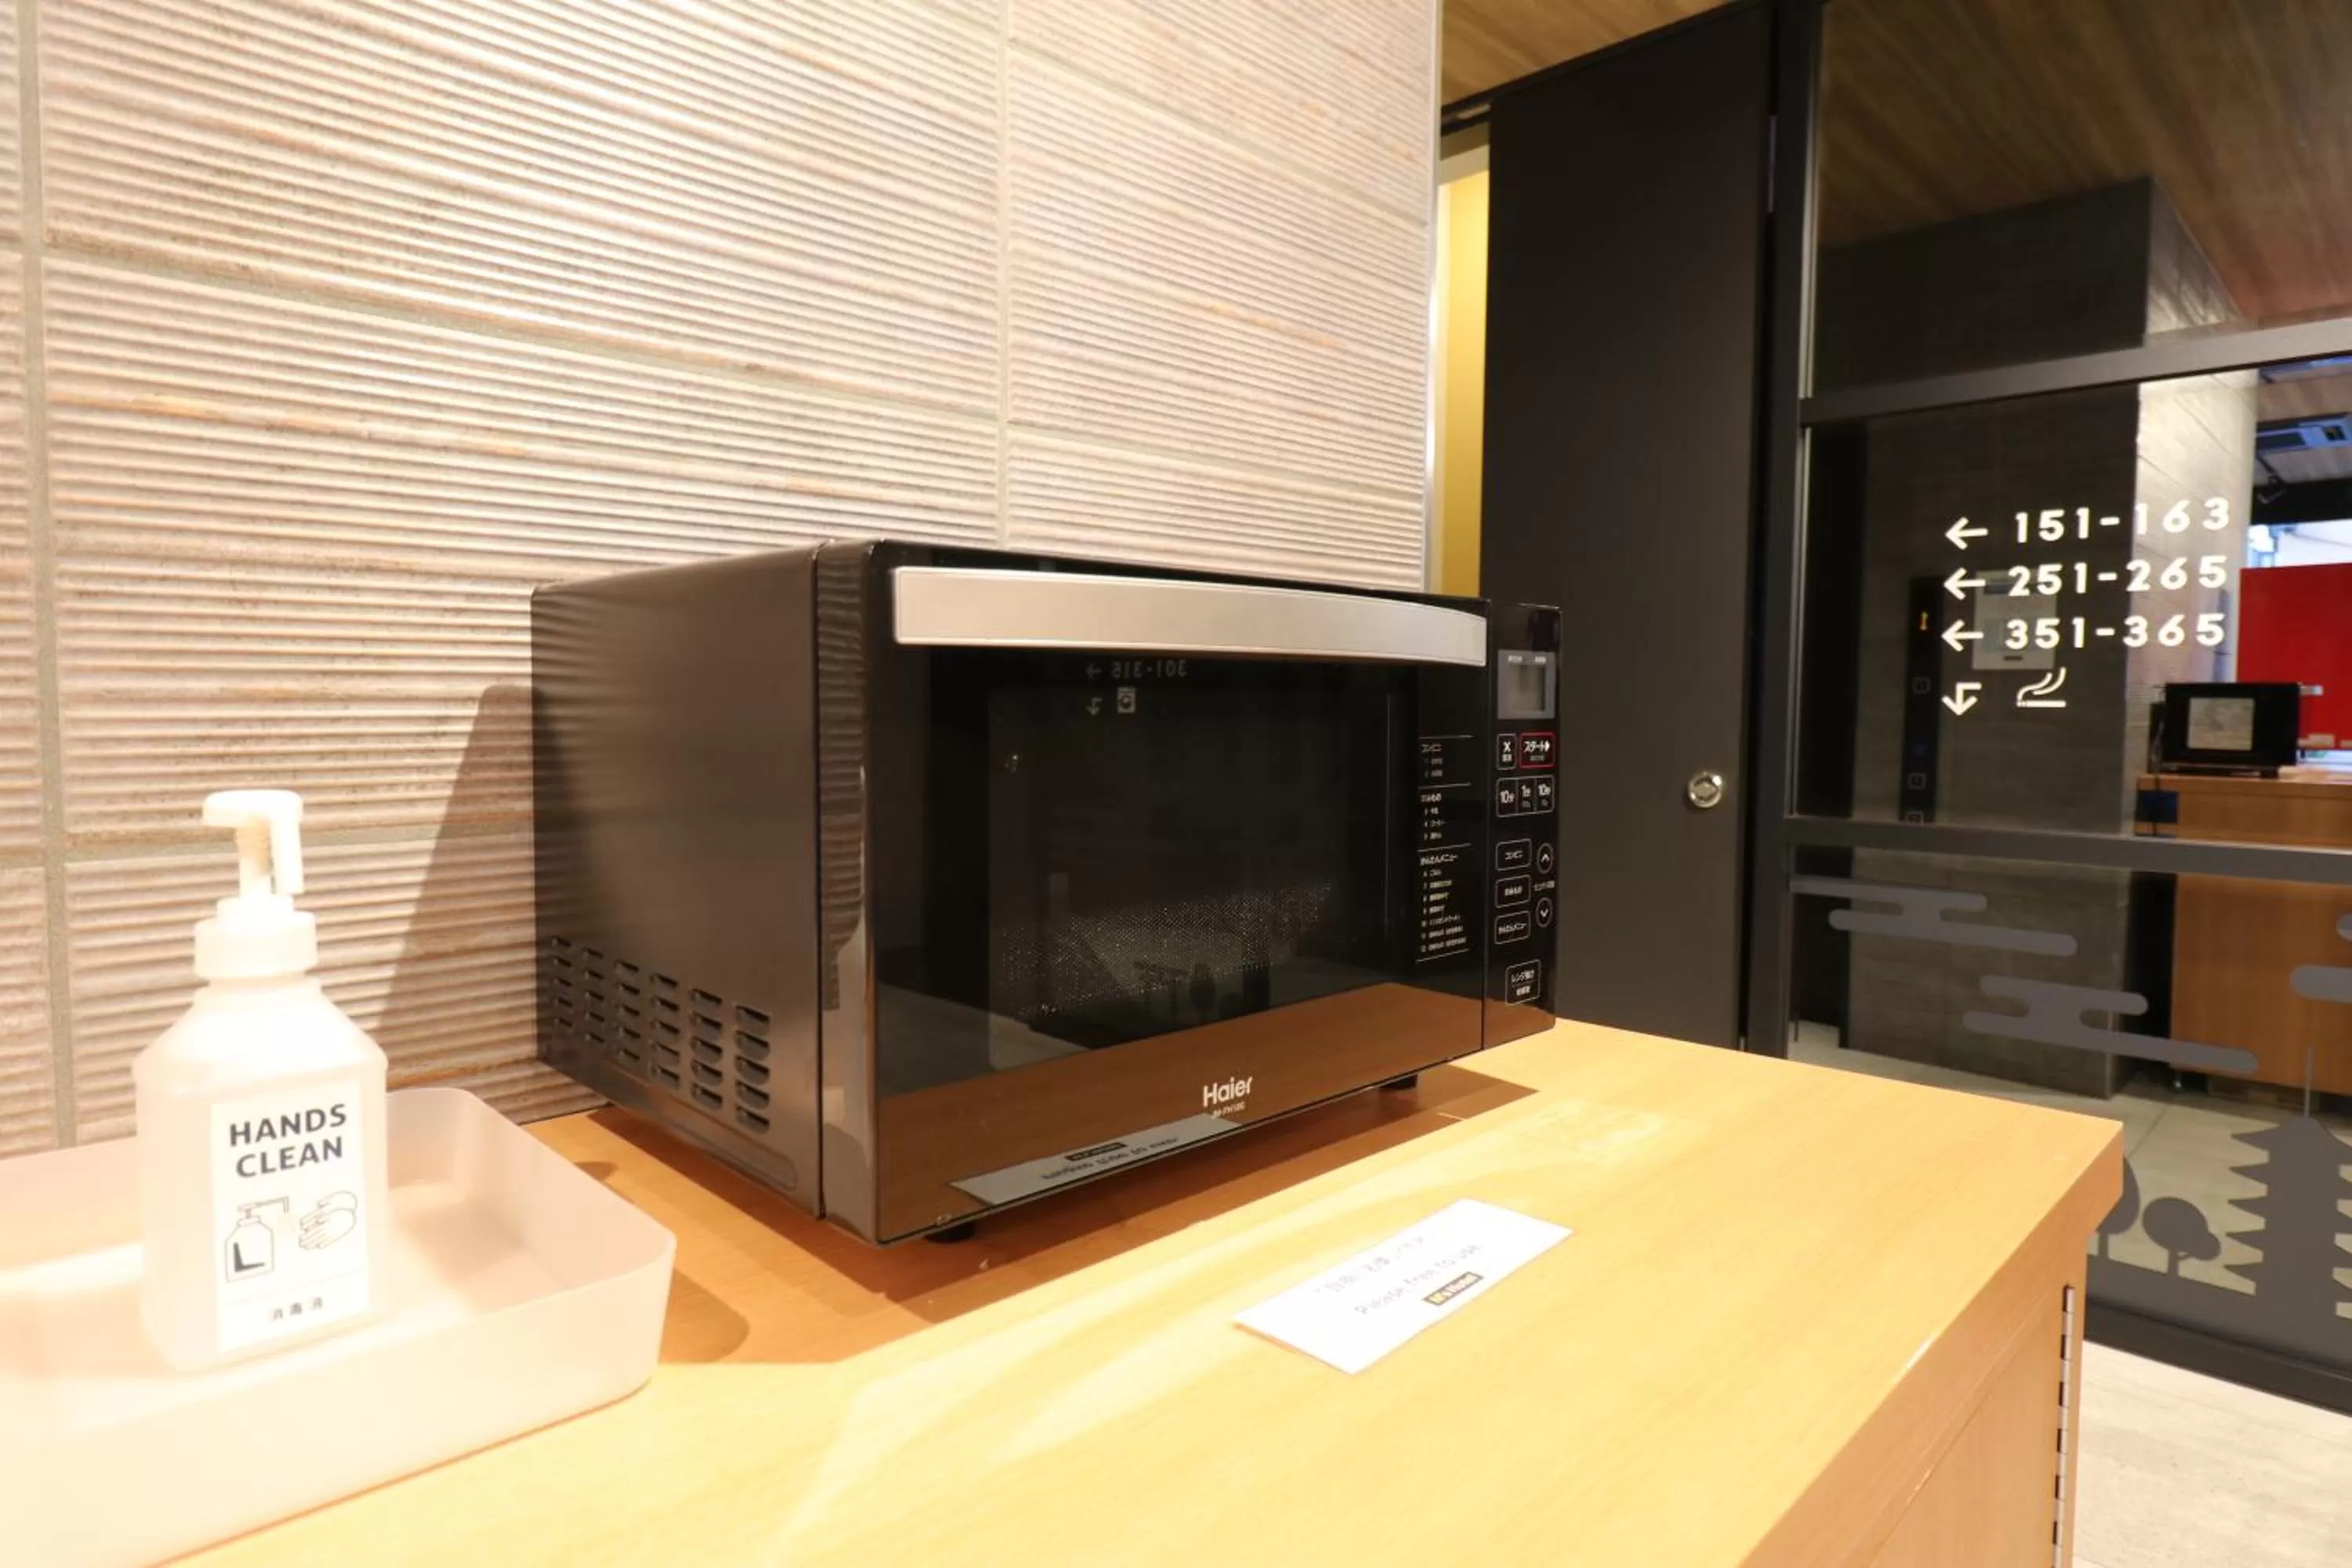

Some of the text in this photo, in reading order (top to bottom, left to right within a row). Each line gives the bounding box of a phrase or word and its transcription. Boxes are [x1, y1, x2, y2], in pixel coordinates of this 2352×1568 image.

[2015, 497, 2230, 543] 151-163
[2008, 555, 2227, 597] 251-265
[2005, 613, 2226, 649] 351-365
[1203, 1076, 1253, 1108] Haier
[230, 1103, 347, 1148] HANDS
[236, 1136, 343, 1178] CLEAN
